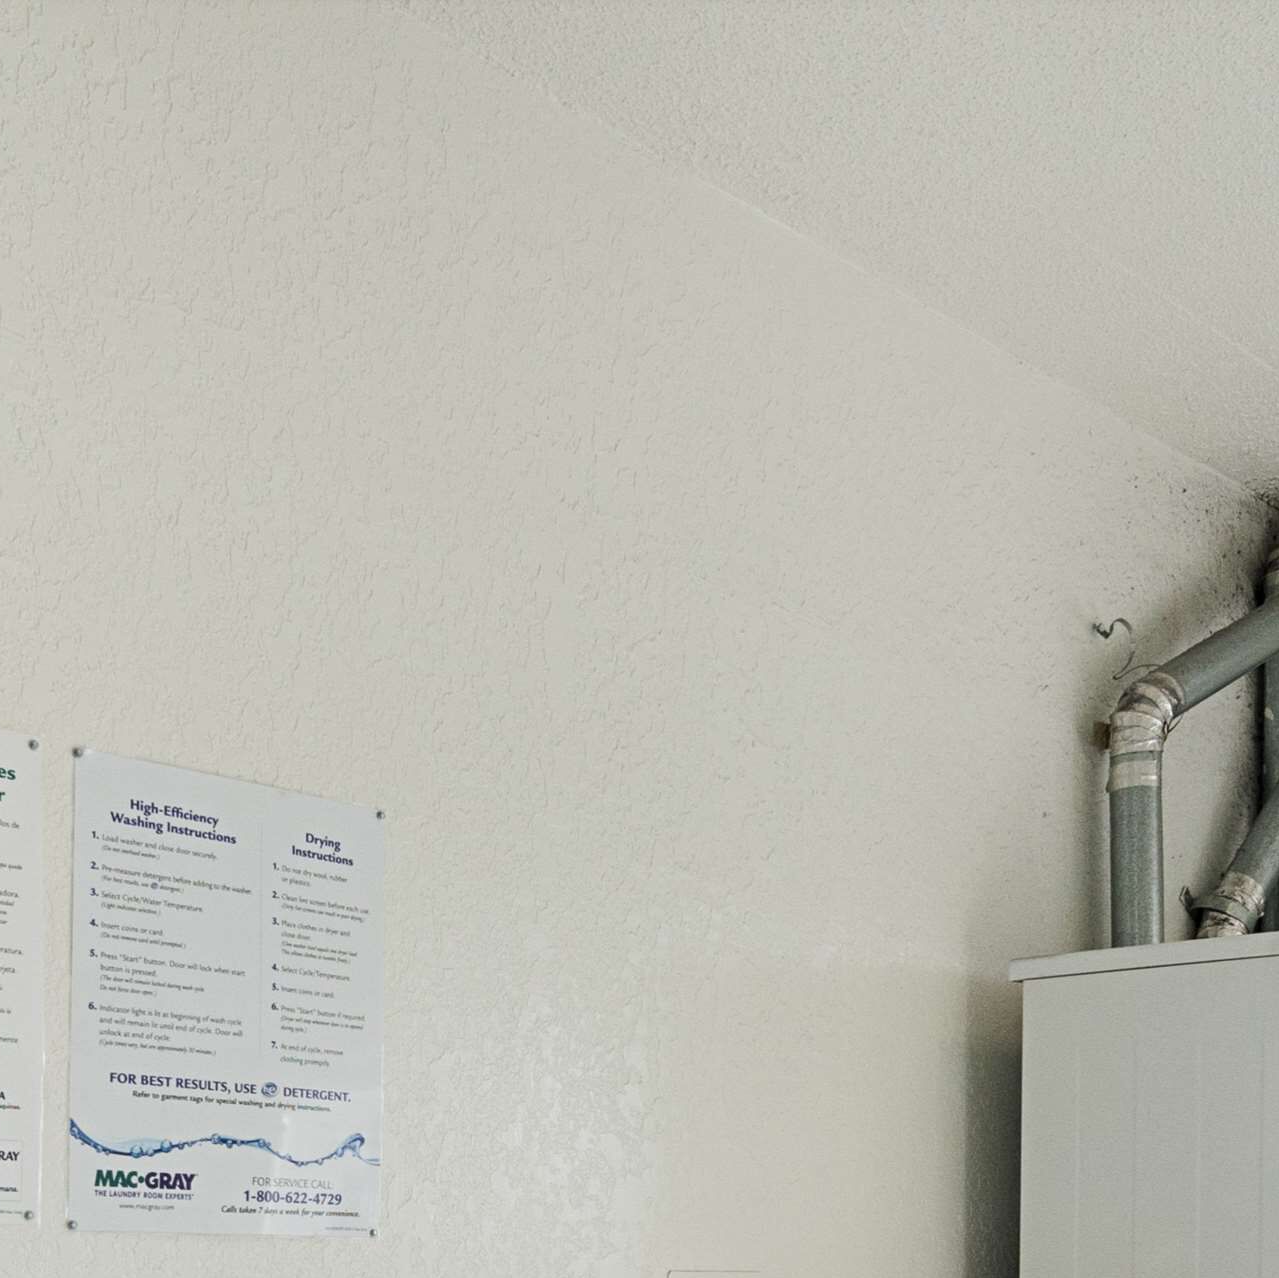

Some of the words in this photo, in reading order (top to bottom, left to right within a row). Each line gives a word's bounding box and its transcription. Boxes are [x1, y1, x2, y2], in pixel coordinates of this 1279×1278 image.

[130, 799, 219, 828] High-Efficiency
[111, 811, 163, 834] Washing
[167, 822, 236, 844] Instructions
[305, 833, 341, 852] Drying
[292, 845, 354, 866] Instructions
[110, 1072, 137, 1085] FOR
[141, 1075, 172, 1087] BEST
[176, 1077, 231, 1094] RESULTS,
[235, 1083, 256, 1094] USE
[283, 1087, 351, 1103] DETERGENT.
[133, 1090, 150, 1098] Refer
[162, 1094, 188, 1102] garment
[216, 1097, 237, 1106] special
[239, 1099, 263, 1108] washing
[277, 1102, 295, 1111] drying
[252, 1177, 270, 1186] FOR
[273, 1178, 309, 1188] SERVICE
[109, 1190, 140, 1198] LAUNDRY
[244, 1190, 342, 1205] 1-800-622-4729
[221, 1205, 237, 1213] Calls
[264, 1207, 278, 1216] days
[301, 1208, 309, 1216] for
[311, 1210, 324, 1218] your
